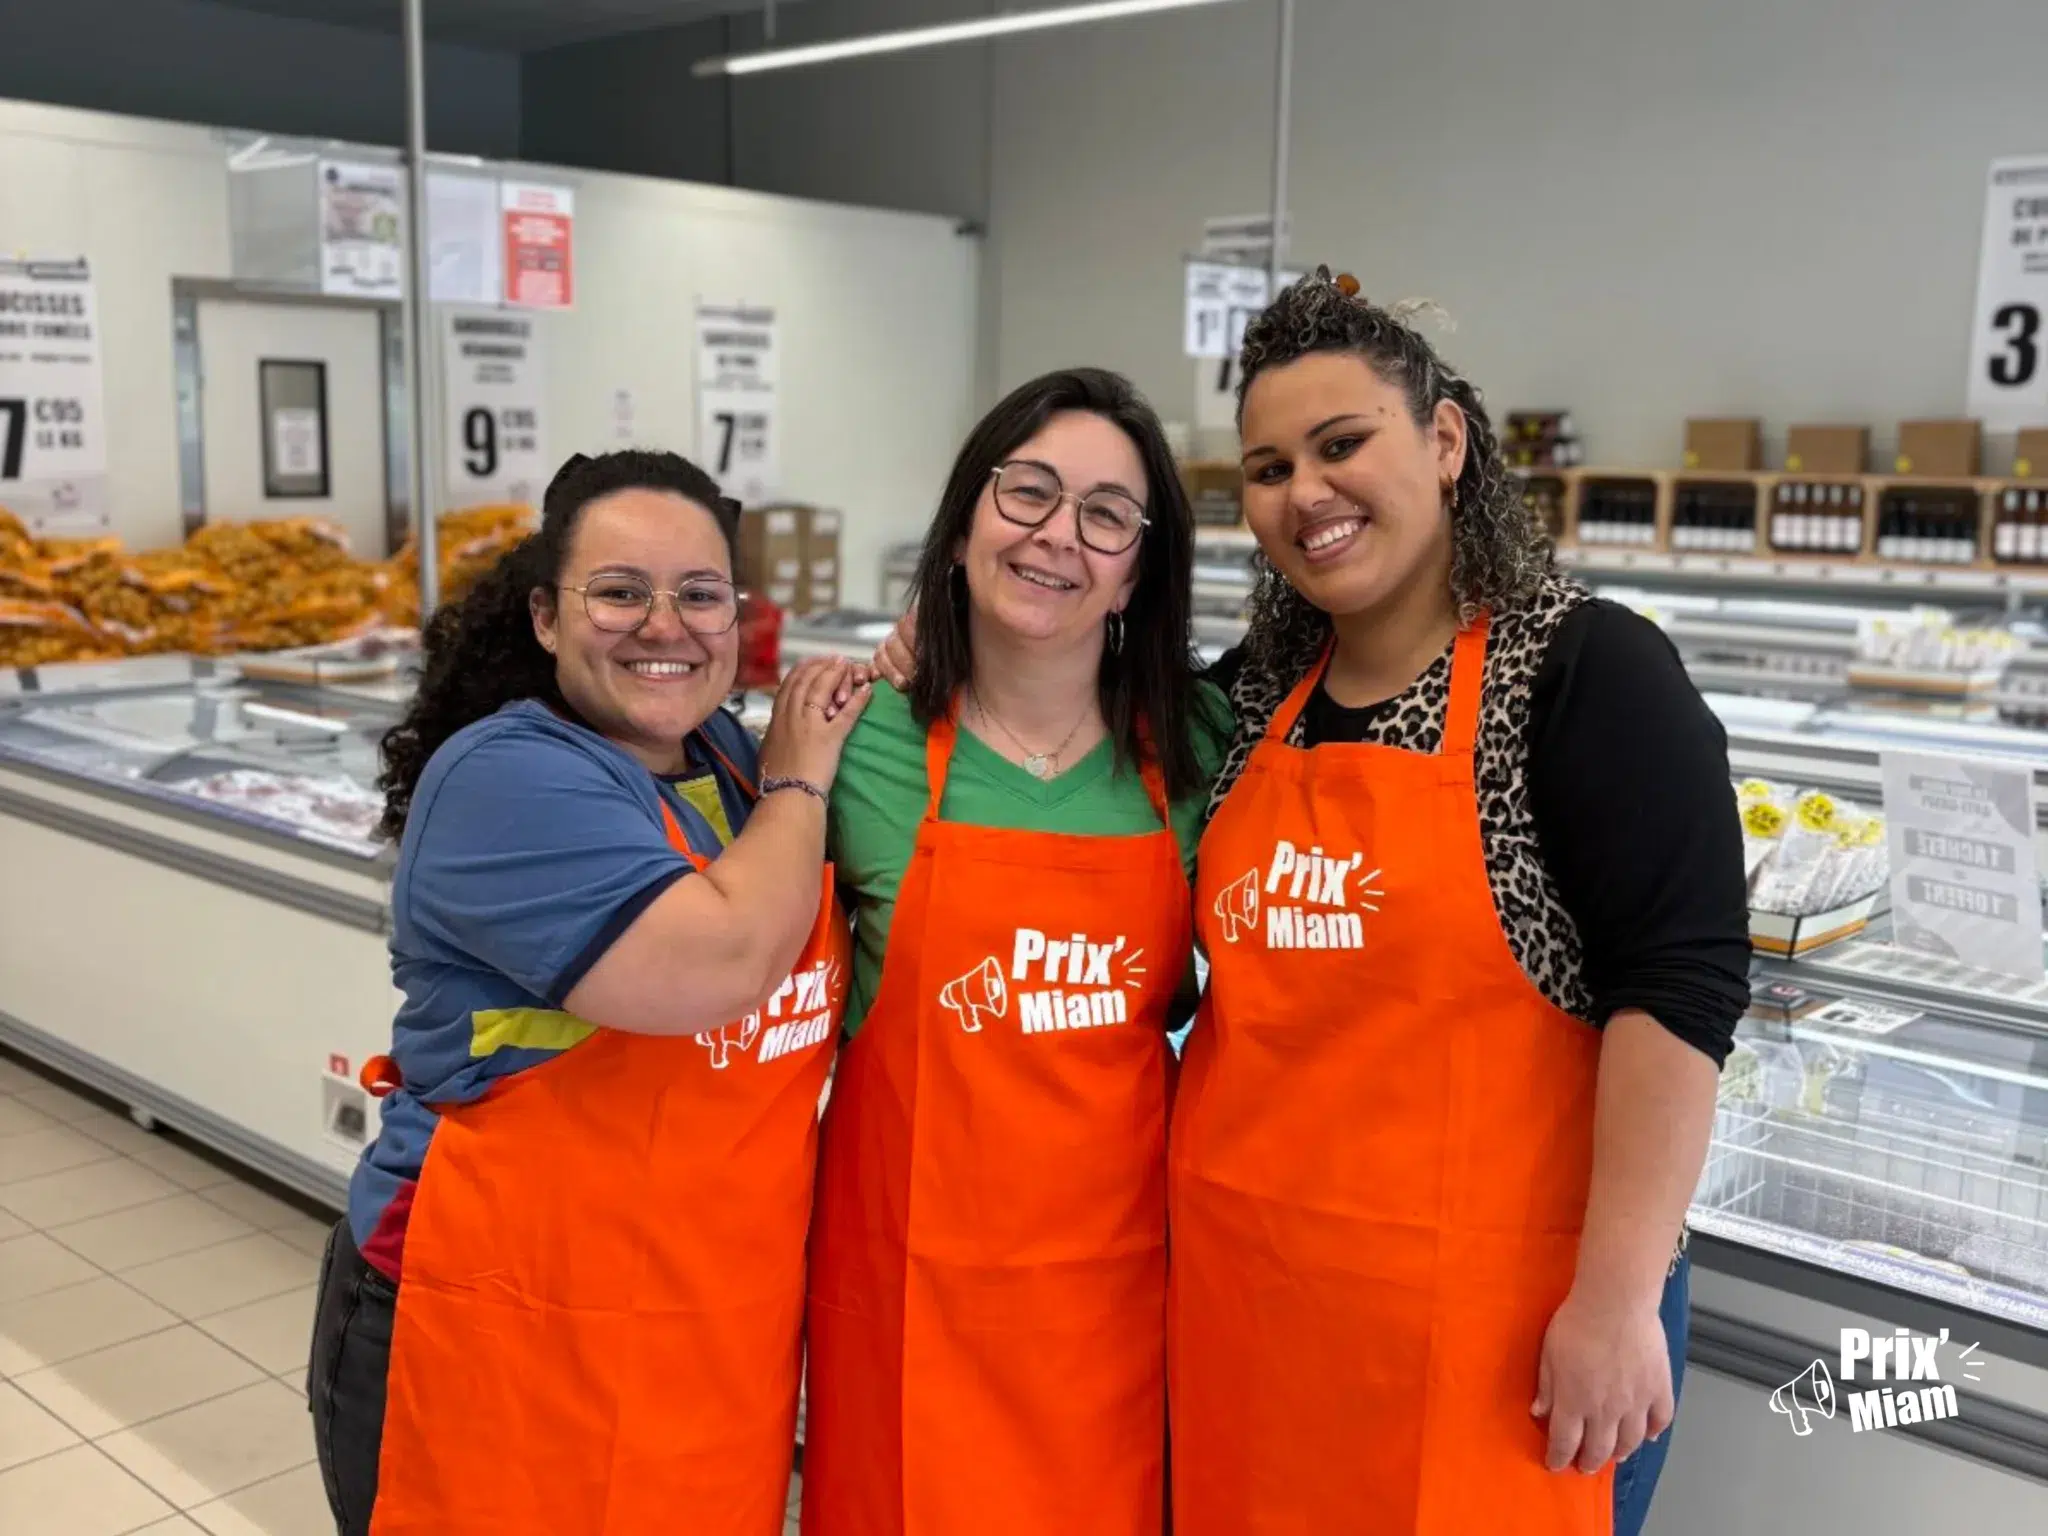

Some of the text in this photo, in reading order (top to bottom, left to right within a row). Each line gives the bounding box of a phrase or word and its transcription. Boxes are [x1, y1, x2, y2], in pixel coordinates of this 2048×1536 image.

[1988, 303, 2041, 387] 3
[0, 399, 26, 480] 7
[464, 406, 497, 478] 9
[715, 413, 735, 474] 7
[1265, 840, 1363, 907] Prix'
[1011, 928, 1126, 985] Prix'
[1267, 906, 1364, 949] Miam
[757, 1009, 831, 1064] Miam
[1018, 989, 1127, 1034] Miam
